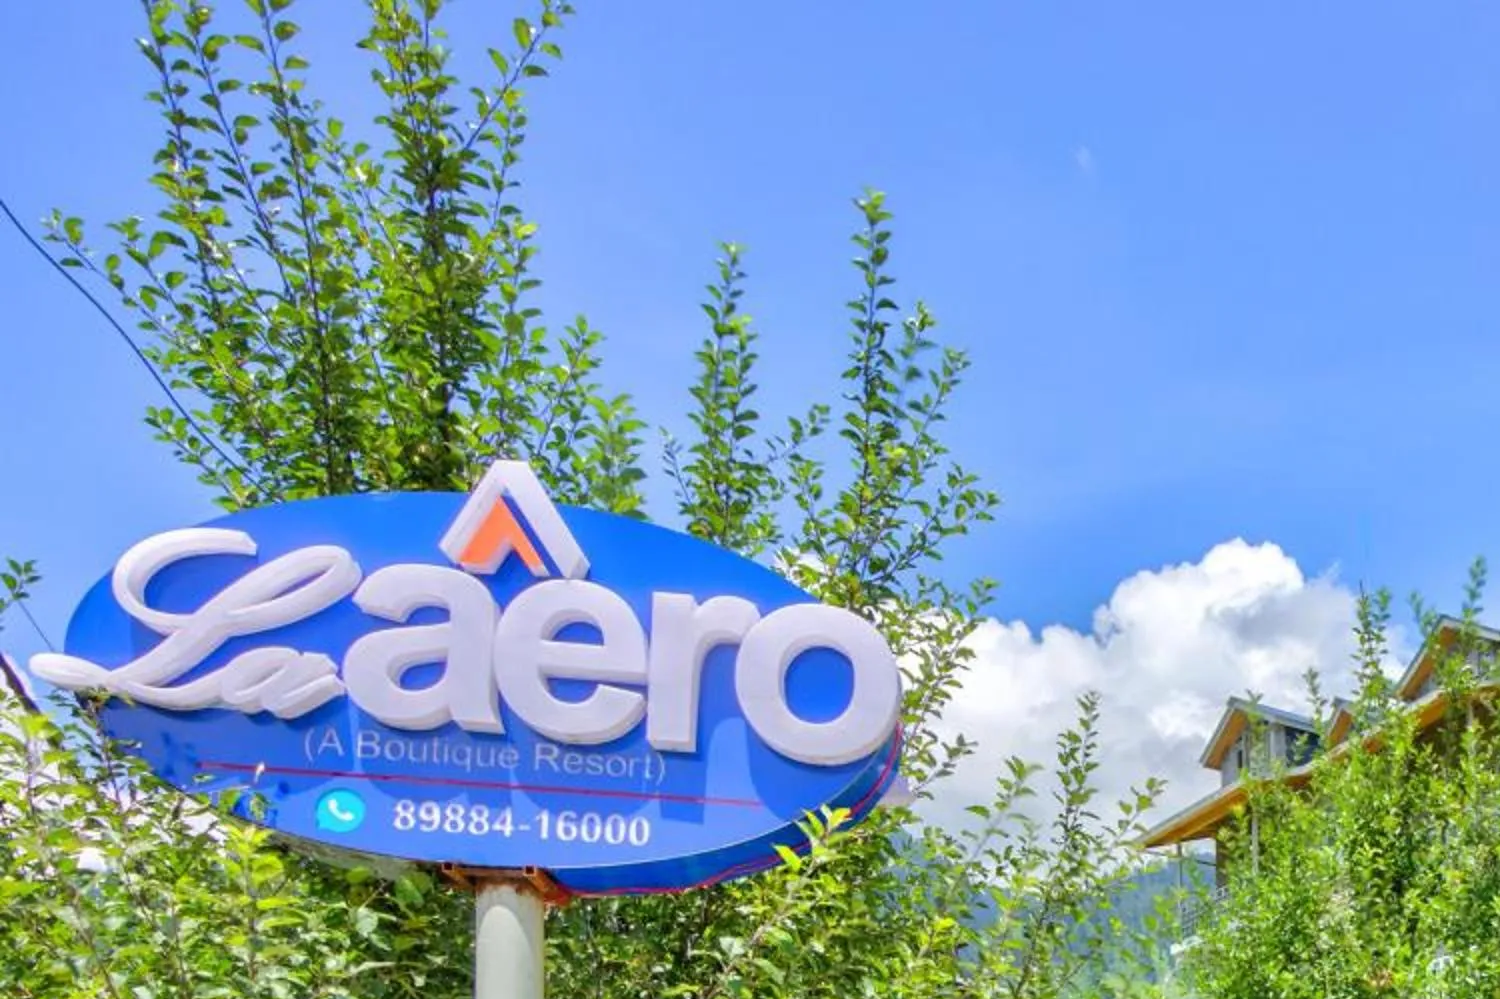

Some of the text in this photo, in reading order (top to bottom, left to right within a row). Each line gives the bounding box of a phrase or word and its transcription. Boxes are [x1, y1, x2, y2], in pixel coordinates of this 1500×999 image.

[28, 527, 364, 720] La
[304, 727, 667, 784] (A Boutique Resort)
[392, 799, 652, 847] 89884-16000
